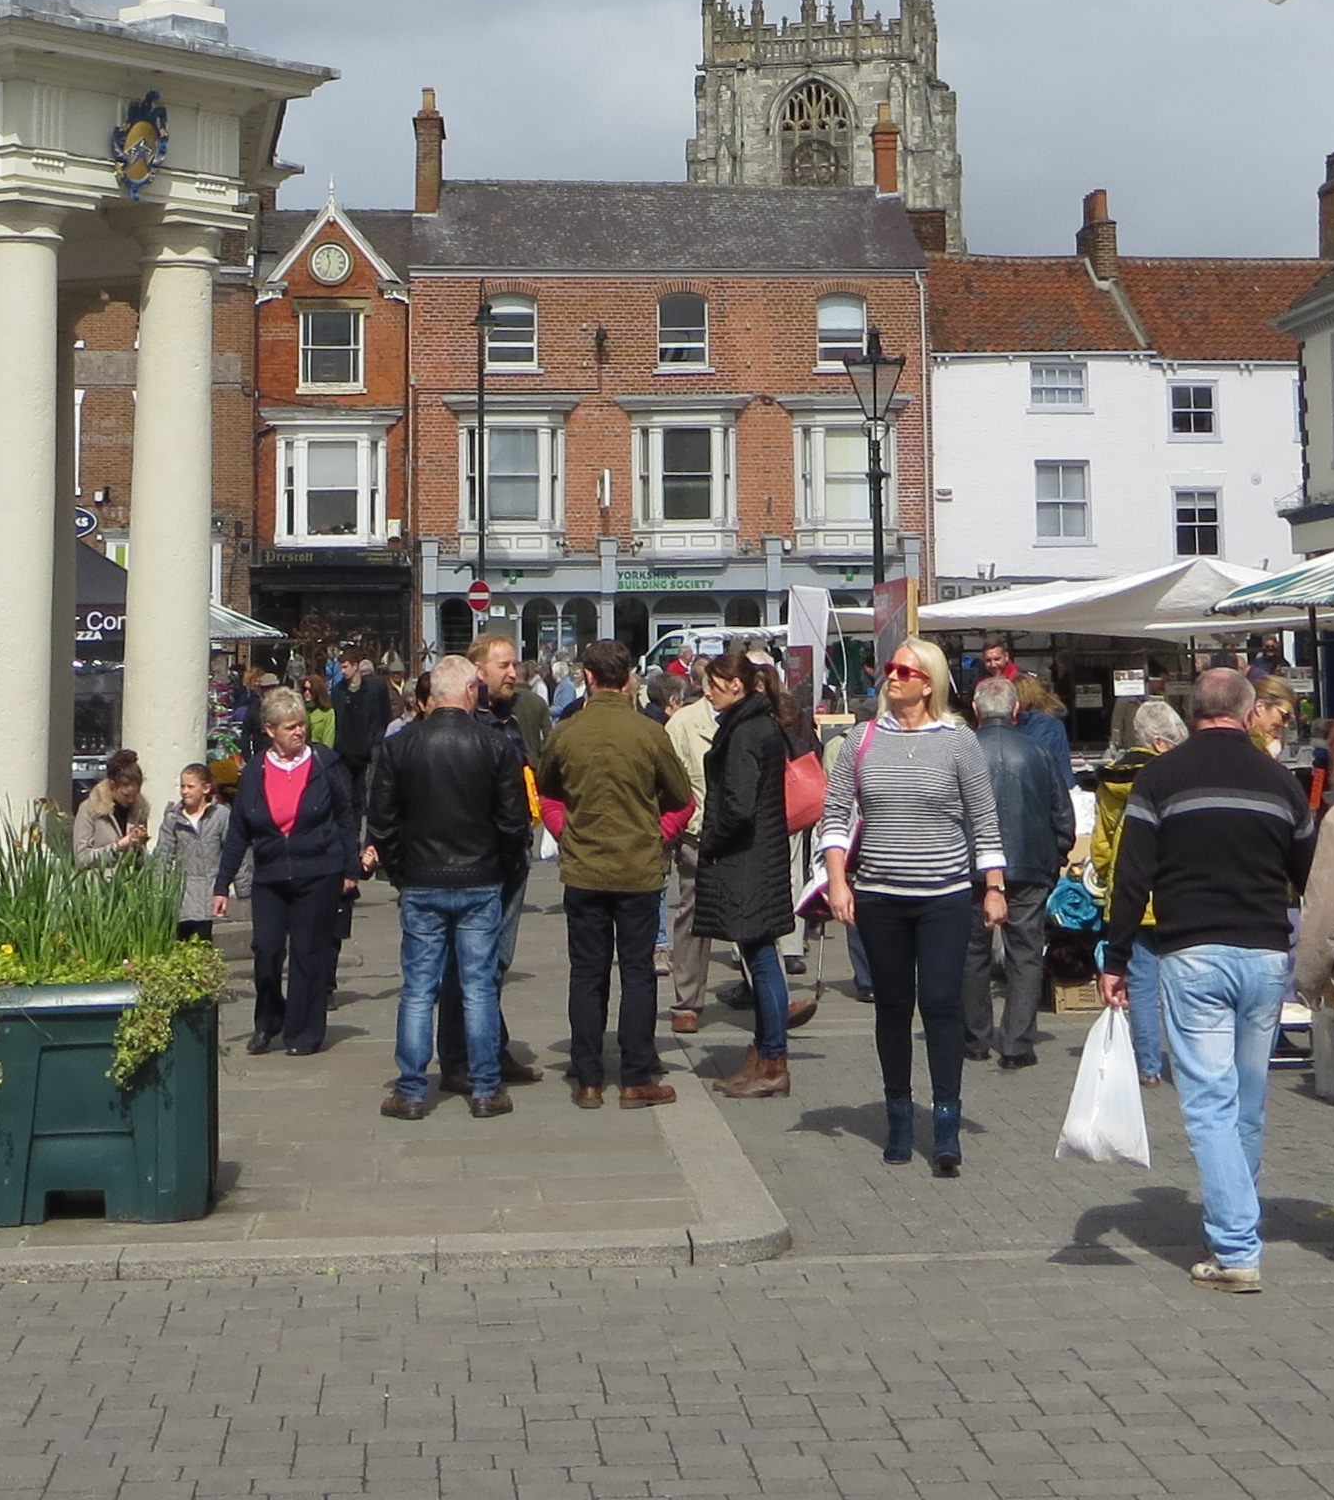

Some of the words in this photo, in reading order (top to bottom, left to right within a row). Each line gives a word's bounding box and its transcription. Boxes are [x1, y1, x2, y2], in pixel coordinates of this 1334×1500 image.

[265, 551, 314, 563] Prescott
[617, 570, 677, 580] YORKSHIRE
[618, 580, 667, 589] BUILDING
[670, 580, 714, 589] SOCIETY
